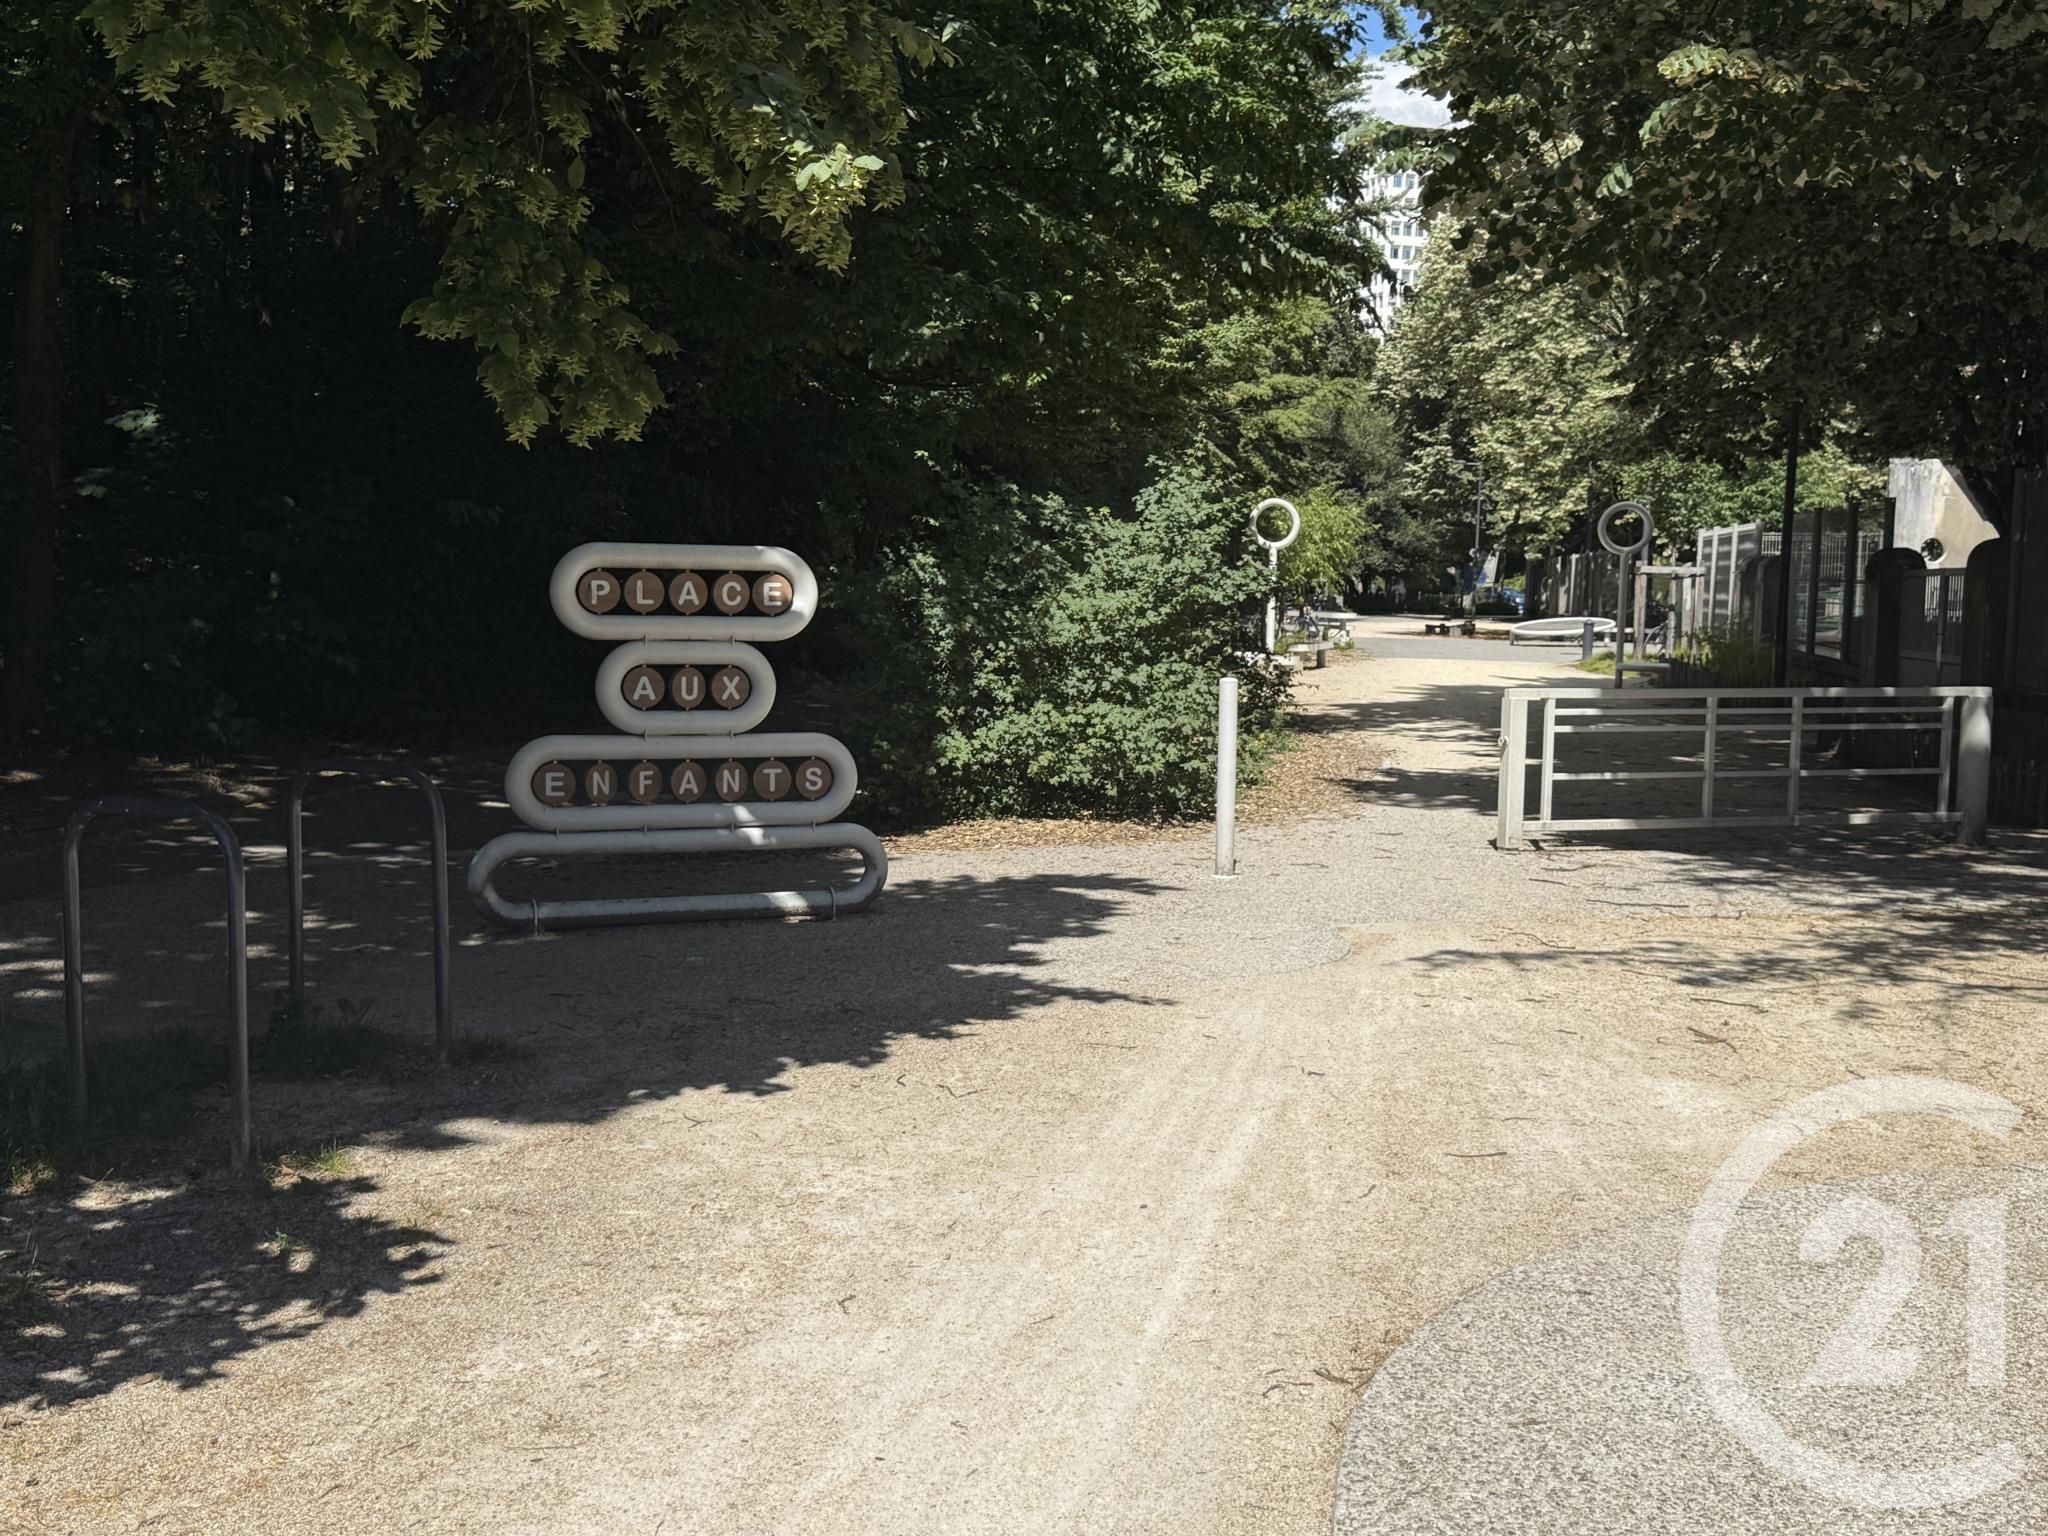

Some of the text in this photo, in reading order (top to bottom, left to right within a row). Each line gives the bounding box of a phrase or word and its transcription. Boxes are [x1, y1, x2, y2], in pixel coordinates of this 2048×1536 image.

[590, 580, 783, 606] PLACE
[632, 675, 741, 700] AUX
[545, 768, 823, 797] ENFANTS
